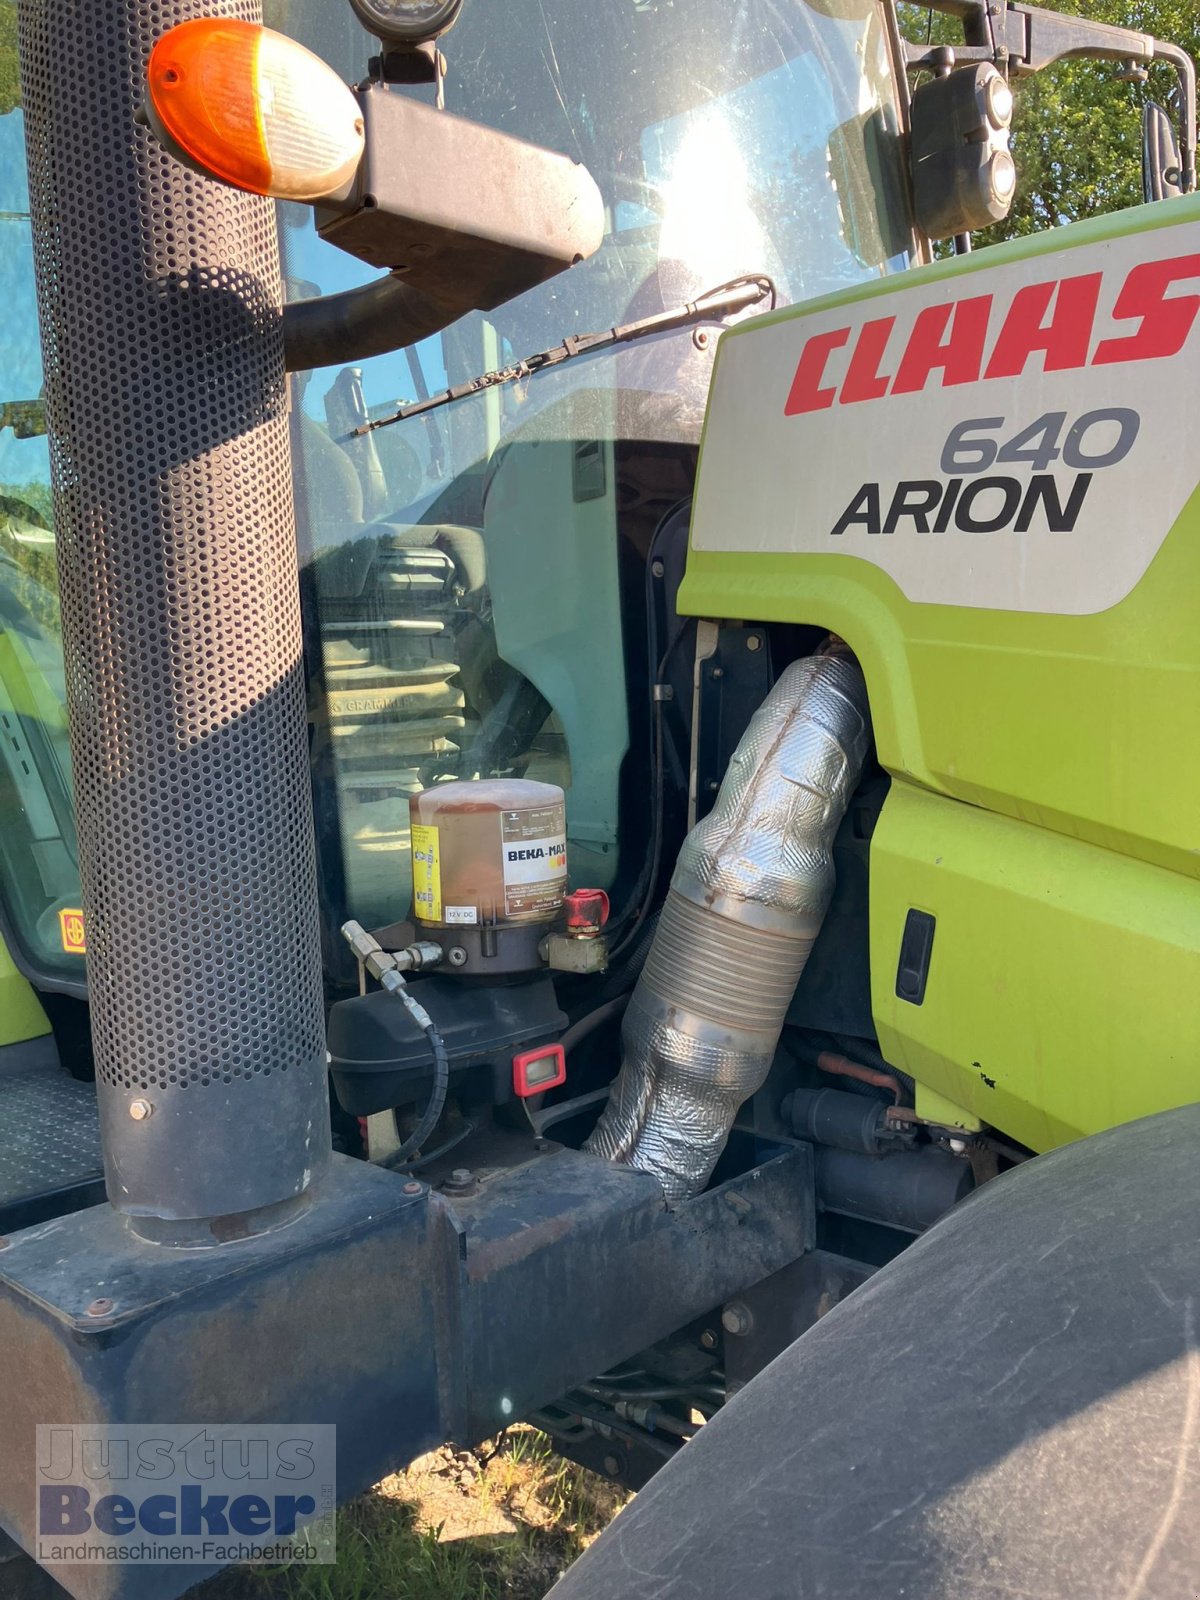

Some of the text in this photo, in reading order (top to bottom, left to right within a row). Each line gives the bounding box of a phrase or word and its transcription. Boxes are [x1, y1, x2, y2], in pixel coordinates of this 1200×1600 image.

[784, 253, 1200, 416] CLAAS
[940, 407, 1141, 475] 640
[830, 472, 1094, 535] ARION
